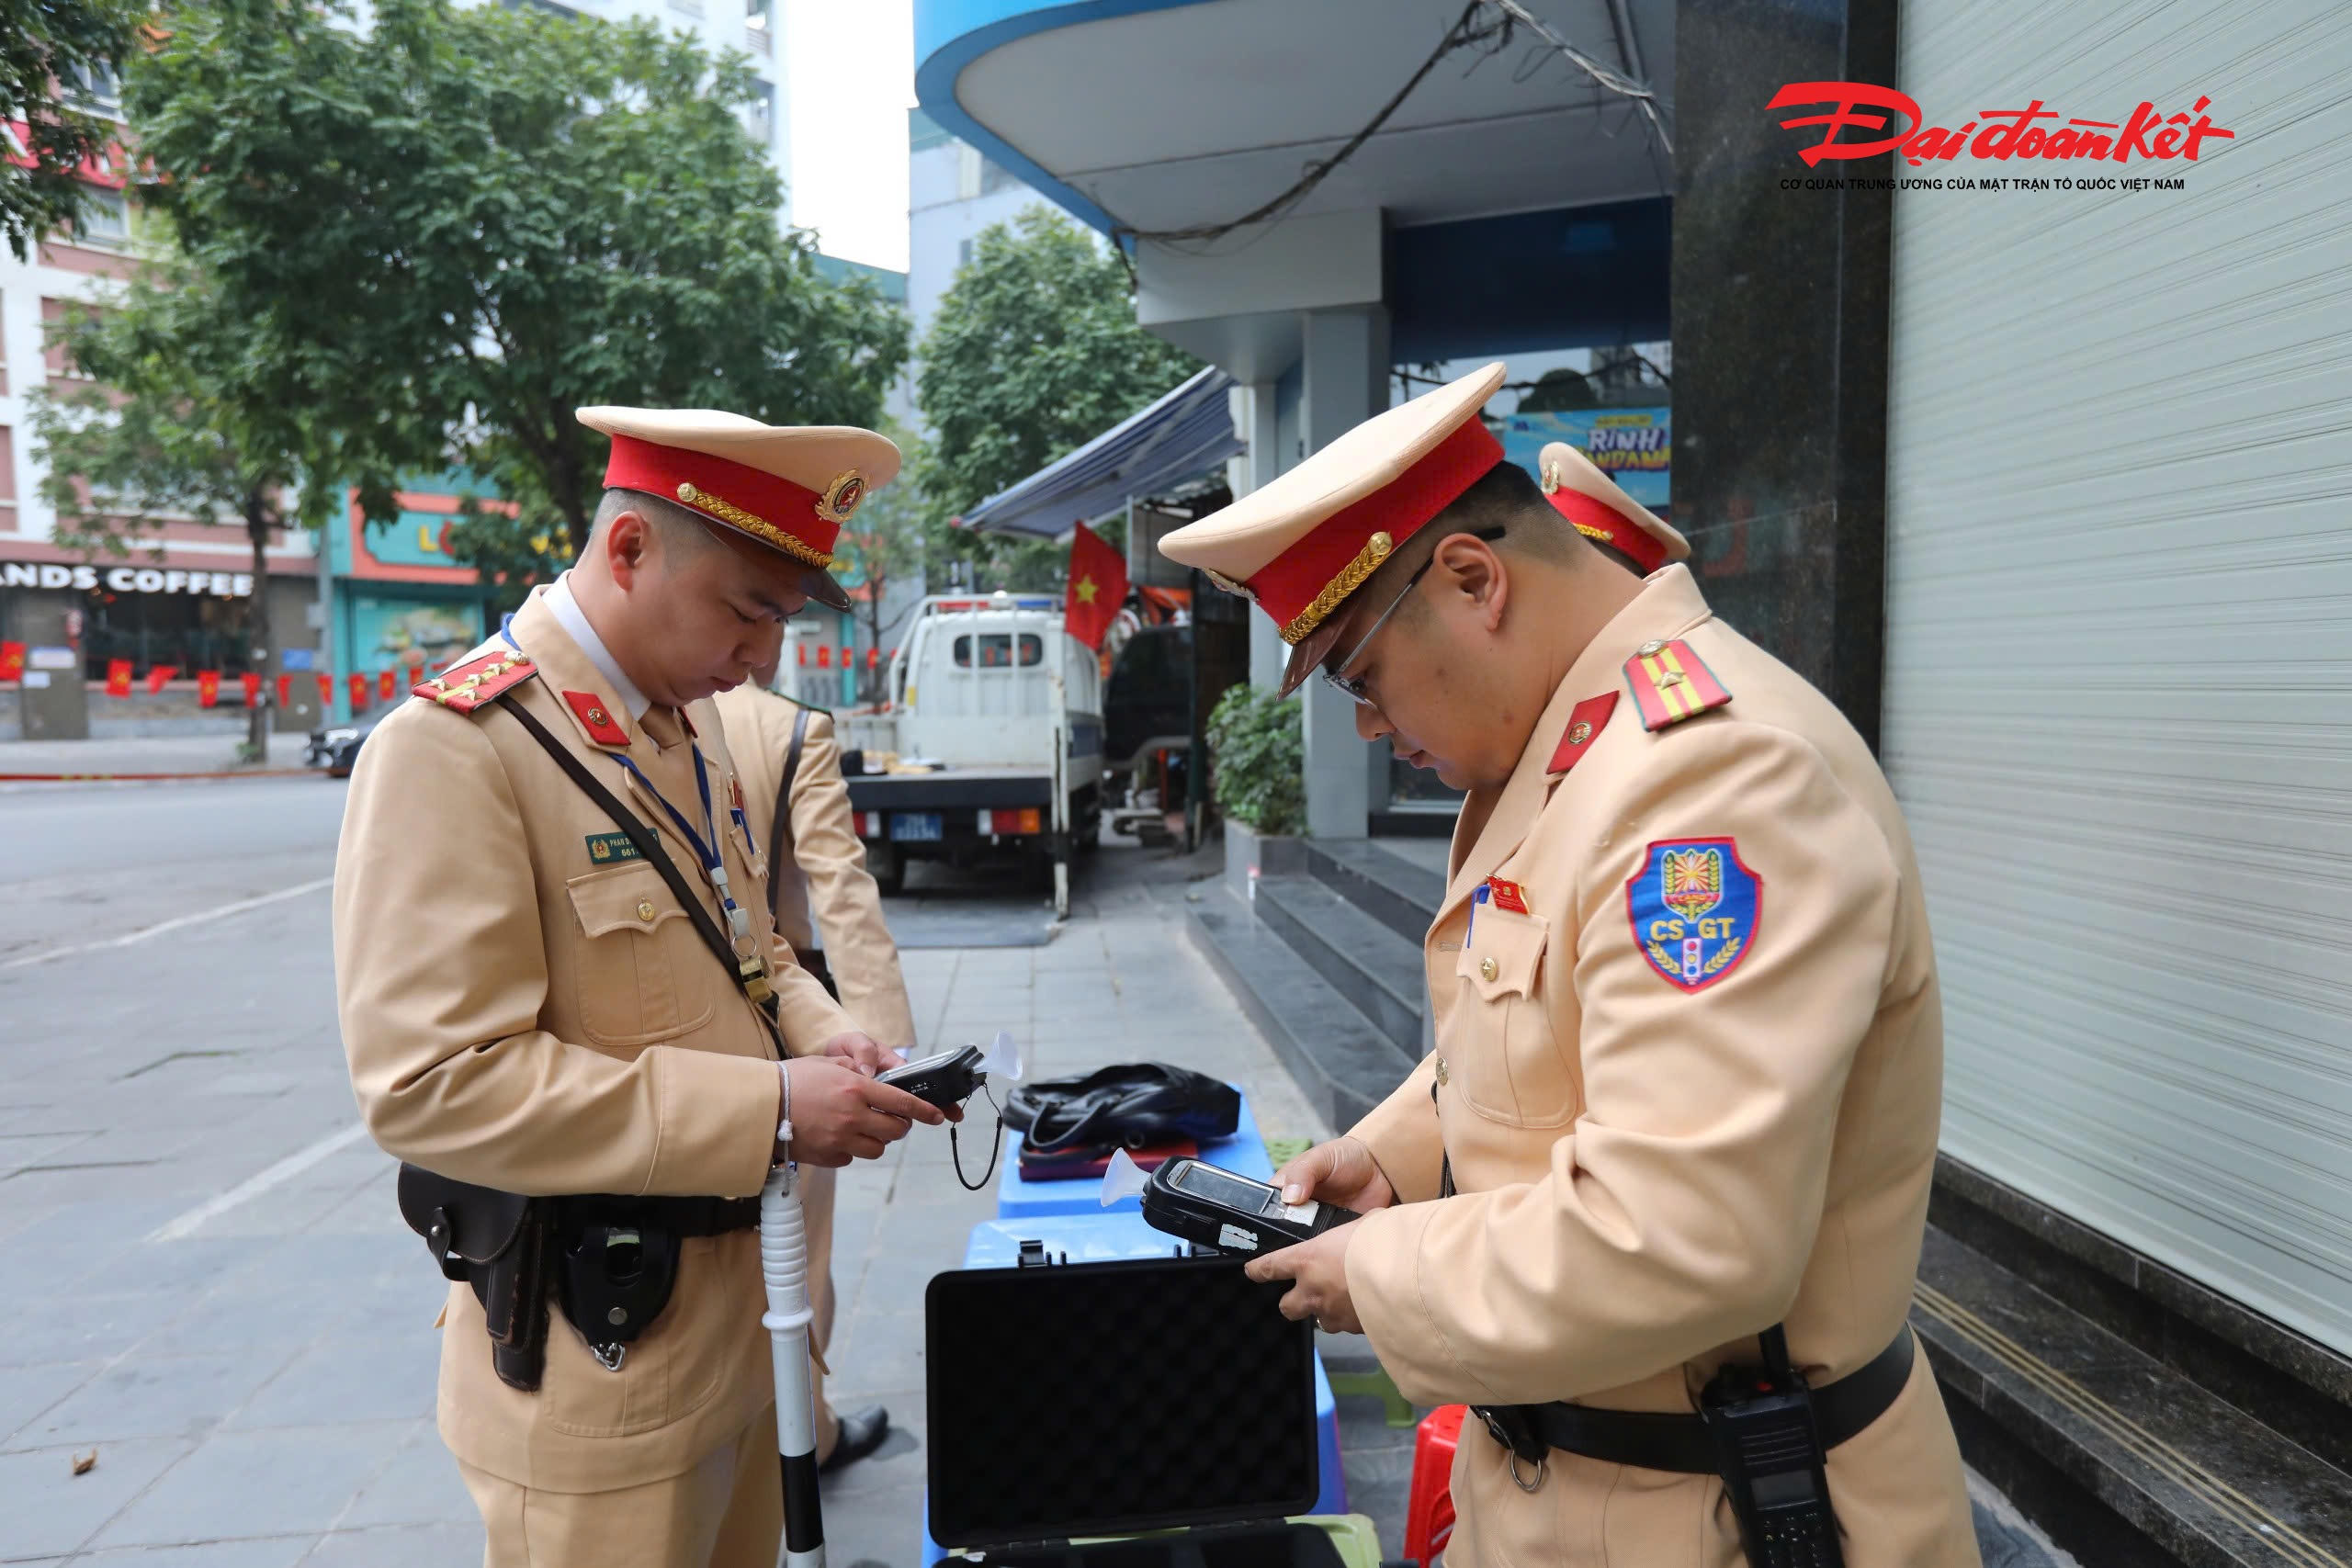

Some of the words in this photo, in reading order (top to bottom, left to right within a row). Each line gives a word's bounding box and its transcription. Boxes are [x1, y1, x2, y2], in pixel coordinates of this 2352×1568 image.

[0, 563, 98, 590] NDS
[107, 568, 254, 596] COFFEE
[1650, 919, 1685, 942] CS
[1697, 917, 1736, 940] GT
